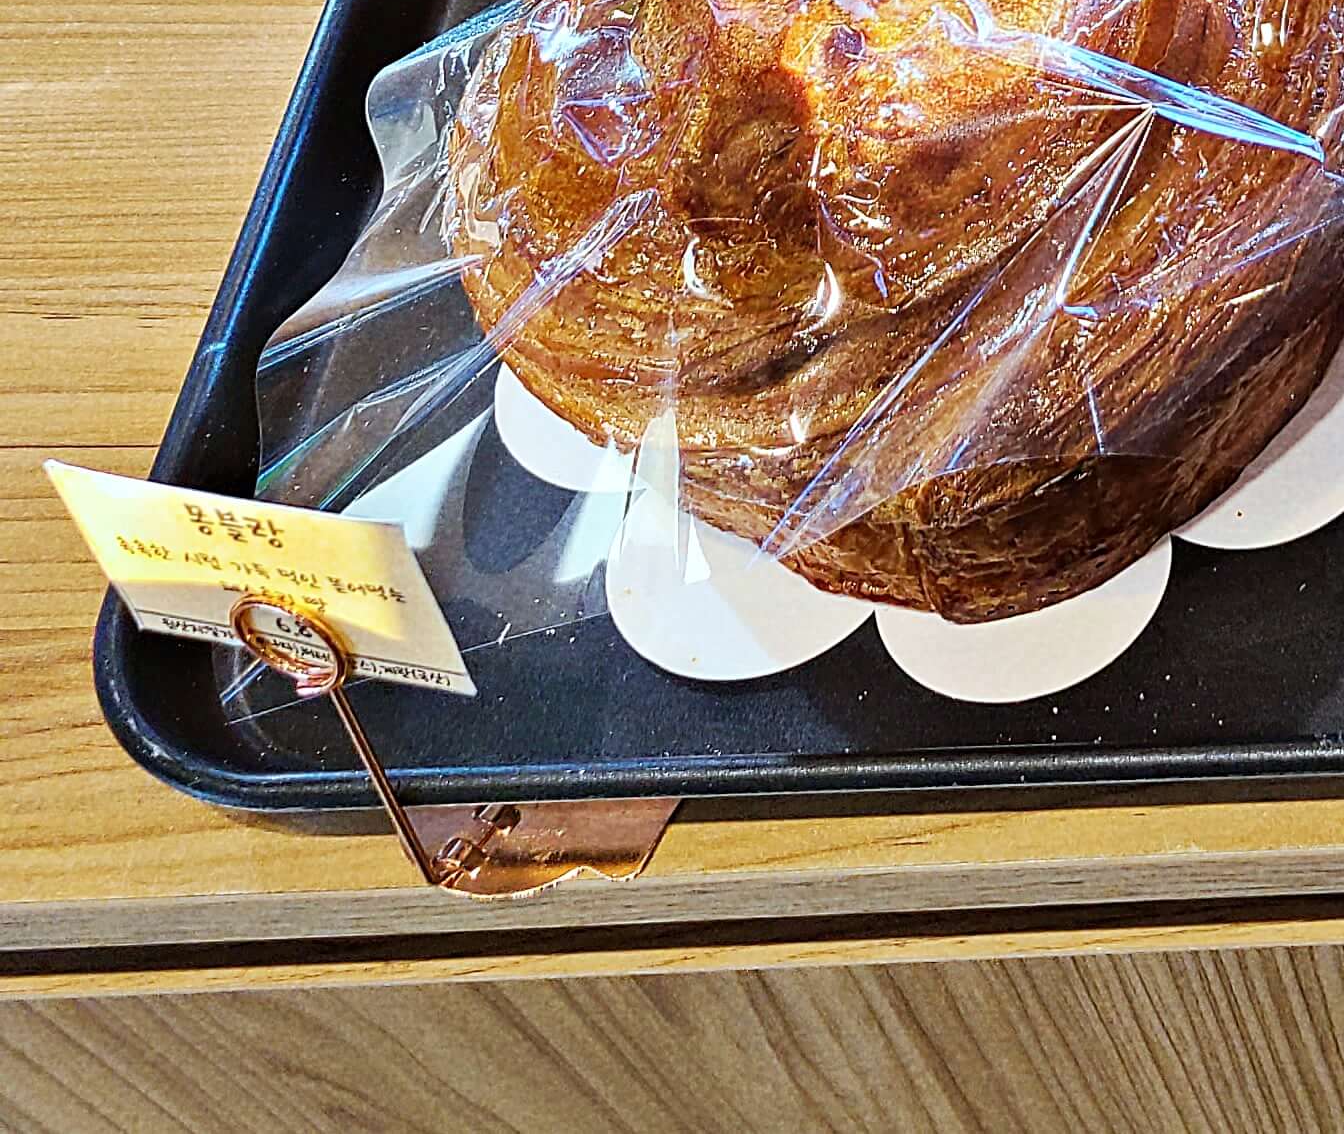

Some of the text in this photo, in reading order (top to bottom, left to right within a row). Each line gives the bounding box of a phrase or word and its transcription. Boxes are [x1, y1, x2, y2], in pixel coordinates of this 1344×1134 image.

[184, 503, 285, 548] 몽블랑
[184, 552, 222, 571] 시럽
[229, 561, 270, 580] 가득
[276, 568, 320, 588] 먹인
